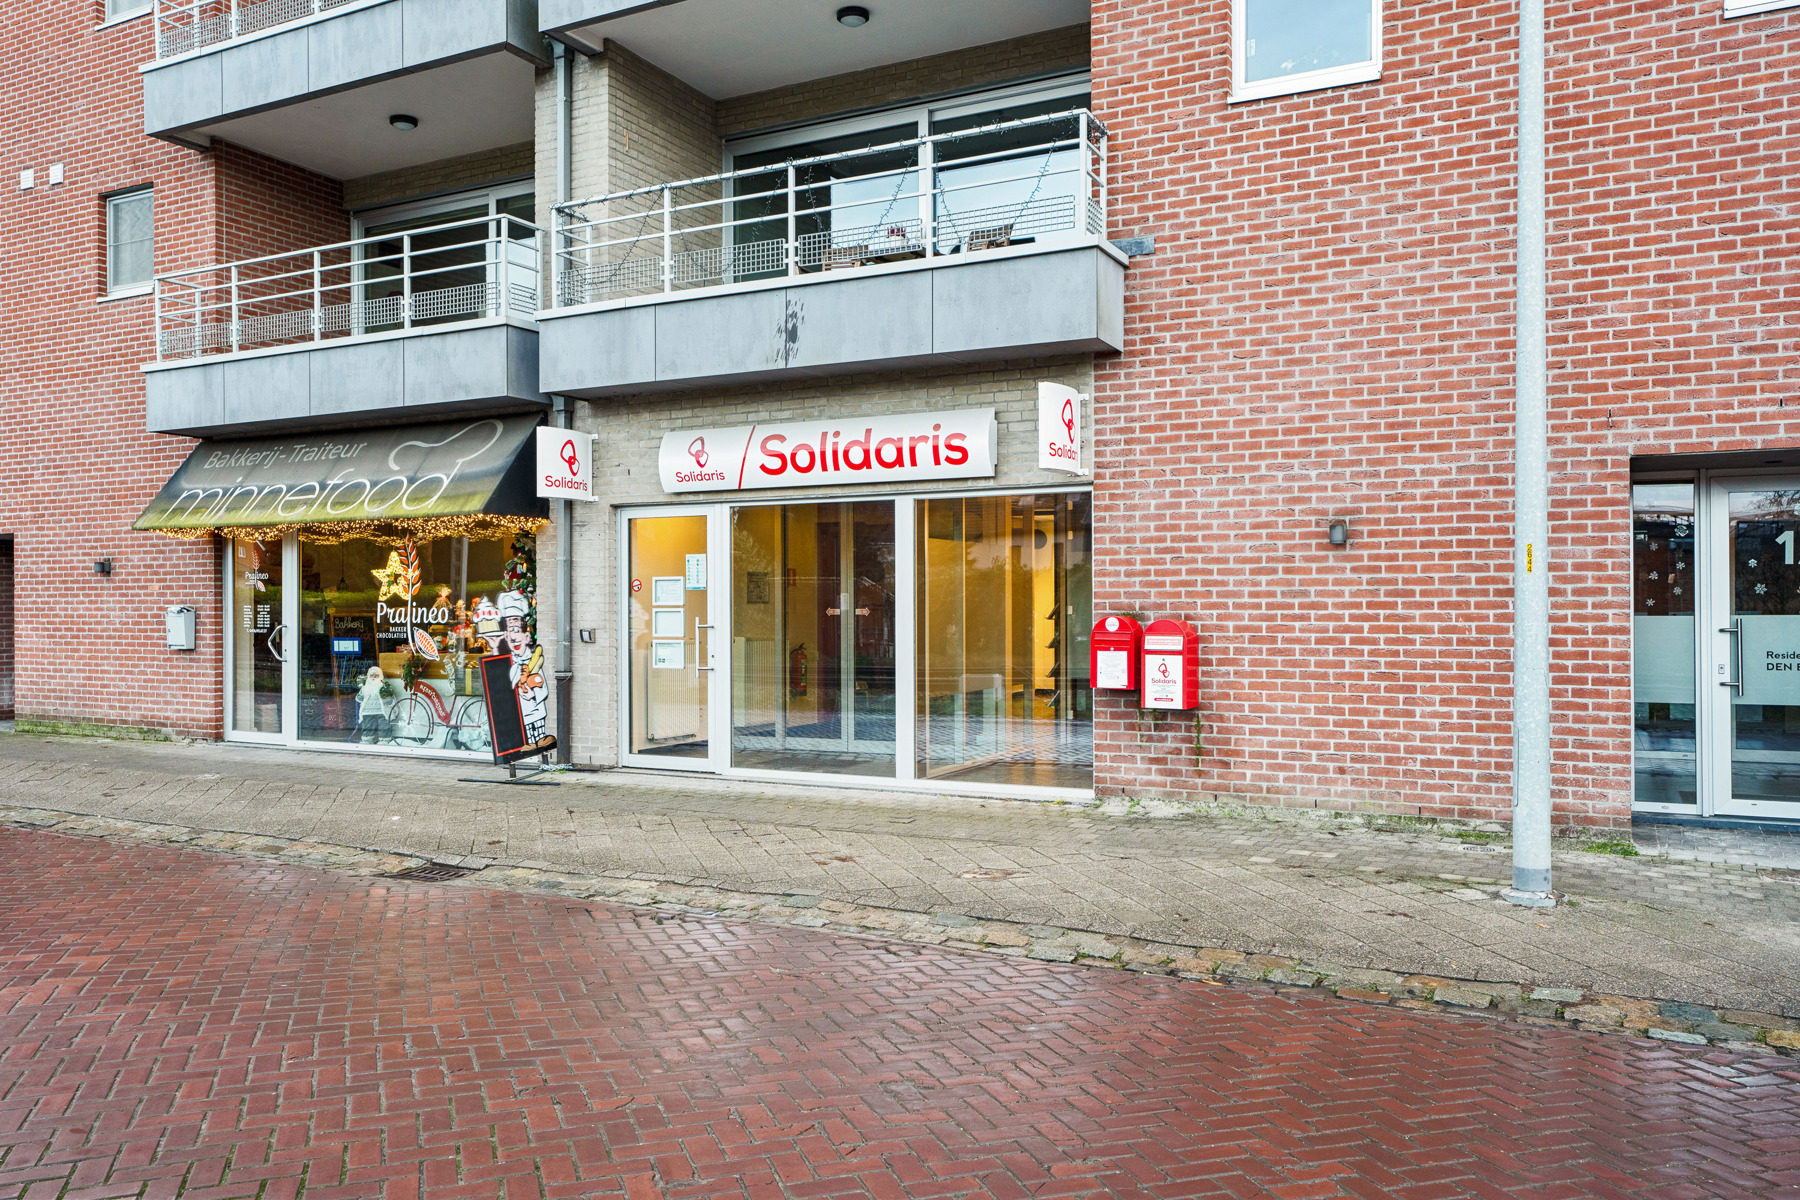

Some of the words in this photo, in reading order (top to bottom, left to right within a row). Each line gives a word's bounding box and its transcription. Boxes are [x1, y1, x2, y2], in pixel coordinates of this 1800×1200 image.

[759, 423, 969, 476] Solidaris
[544, 474, 588, 492] Solidaris
[675, 469, 726, 483] Solidaris
[159, 459, 464, 524] minnefood
[1775, 530, 1800, 565] 1
[376, 601, 449, 624] Pralineo
[1766, 662, 1792, 671] DEN
